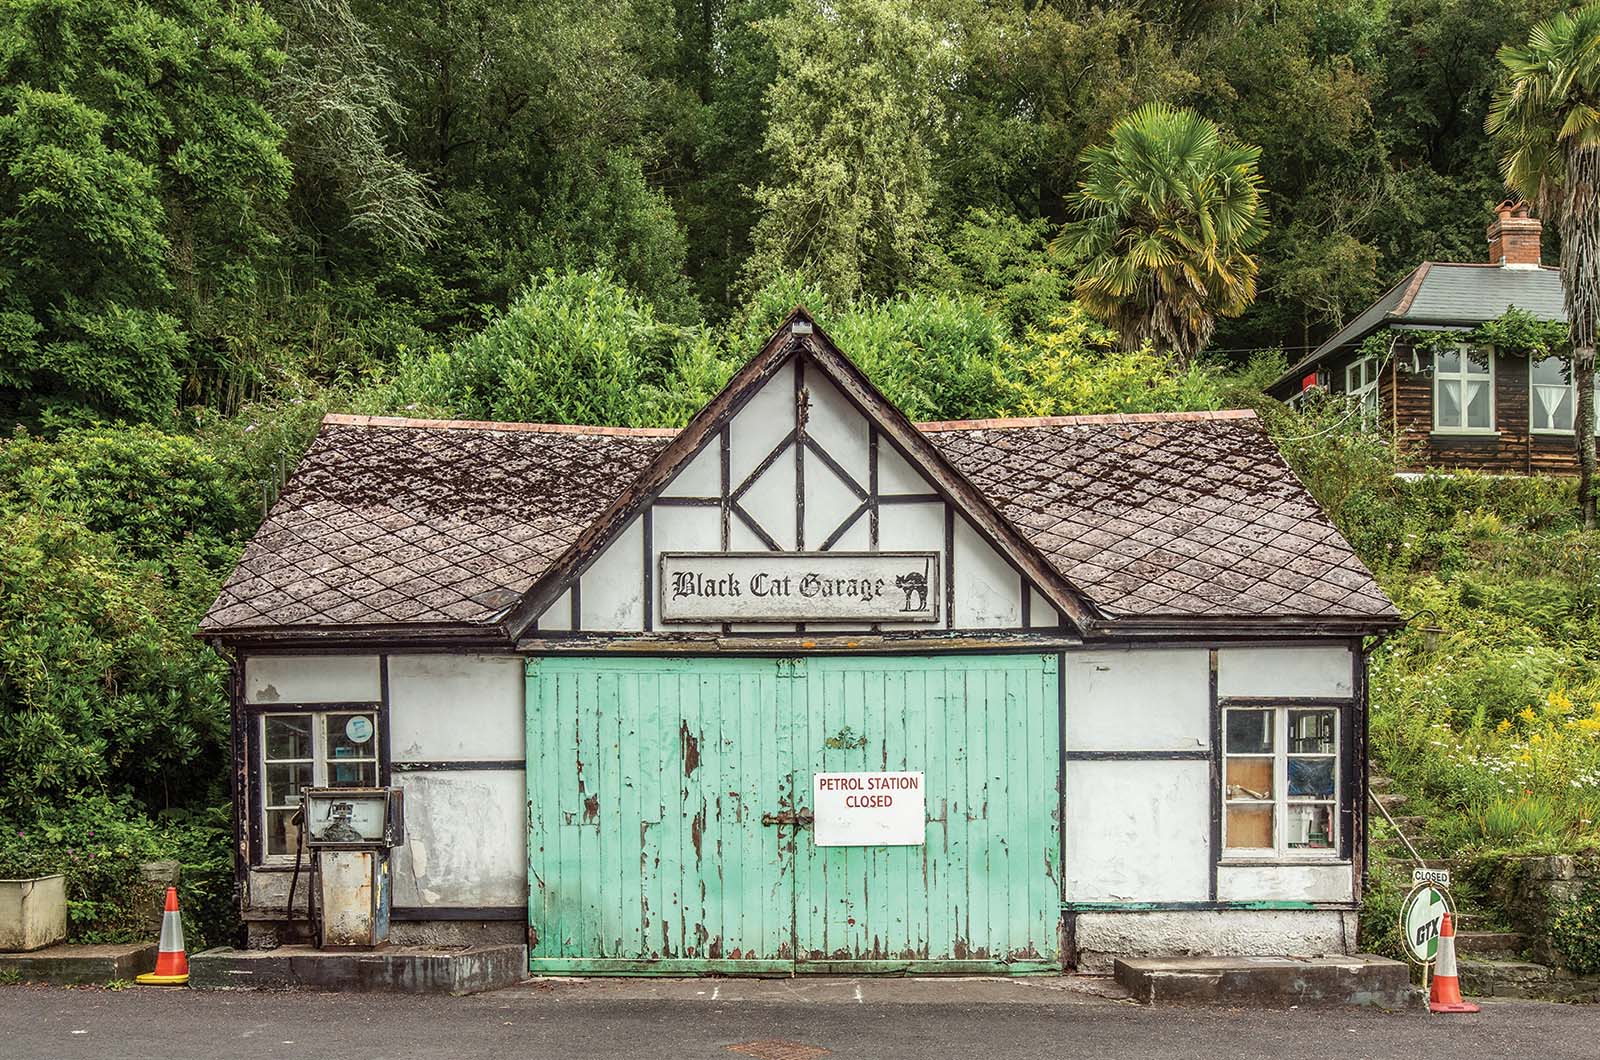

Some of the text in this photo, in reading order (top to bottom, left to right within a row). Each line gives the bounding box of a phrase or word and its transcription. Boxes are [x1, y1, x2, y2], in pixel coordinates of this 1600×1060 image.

[672, 571, 886, 601] Black Cat Garage
[819, 777, 918, 790] PETROL STATION
[846, 795, 893, 808] CLOSED
[1414, 870, 1448, 882] CLOSED
[1416, 916, 1440, 946] GTX
